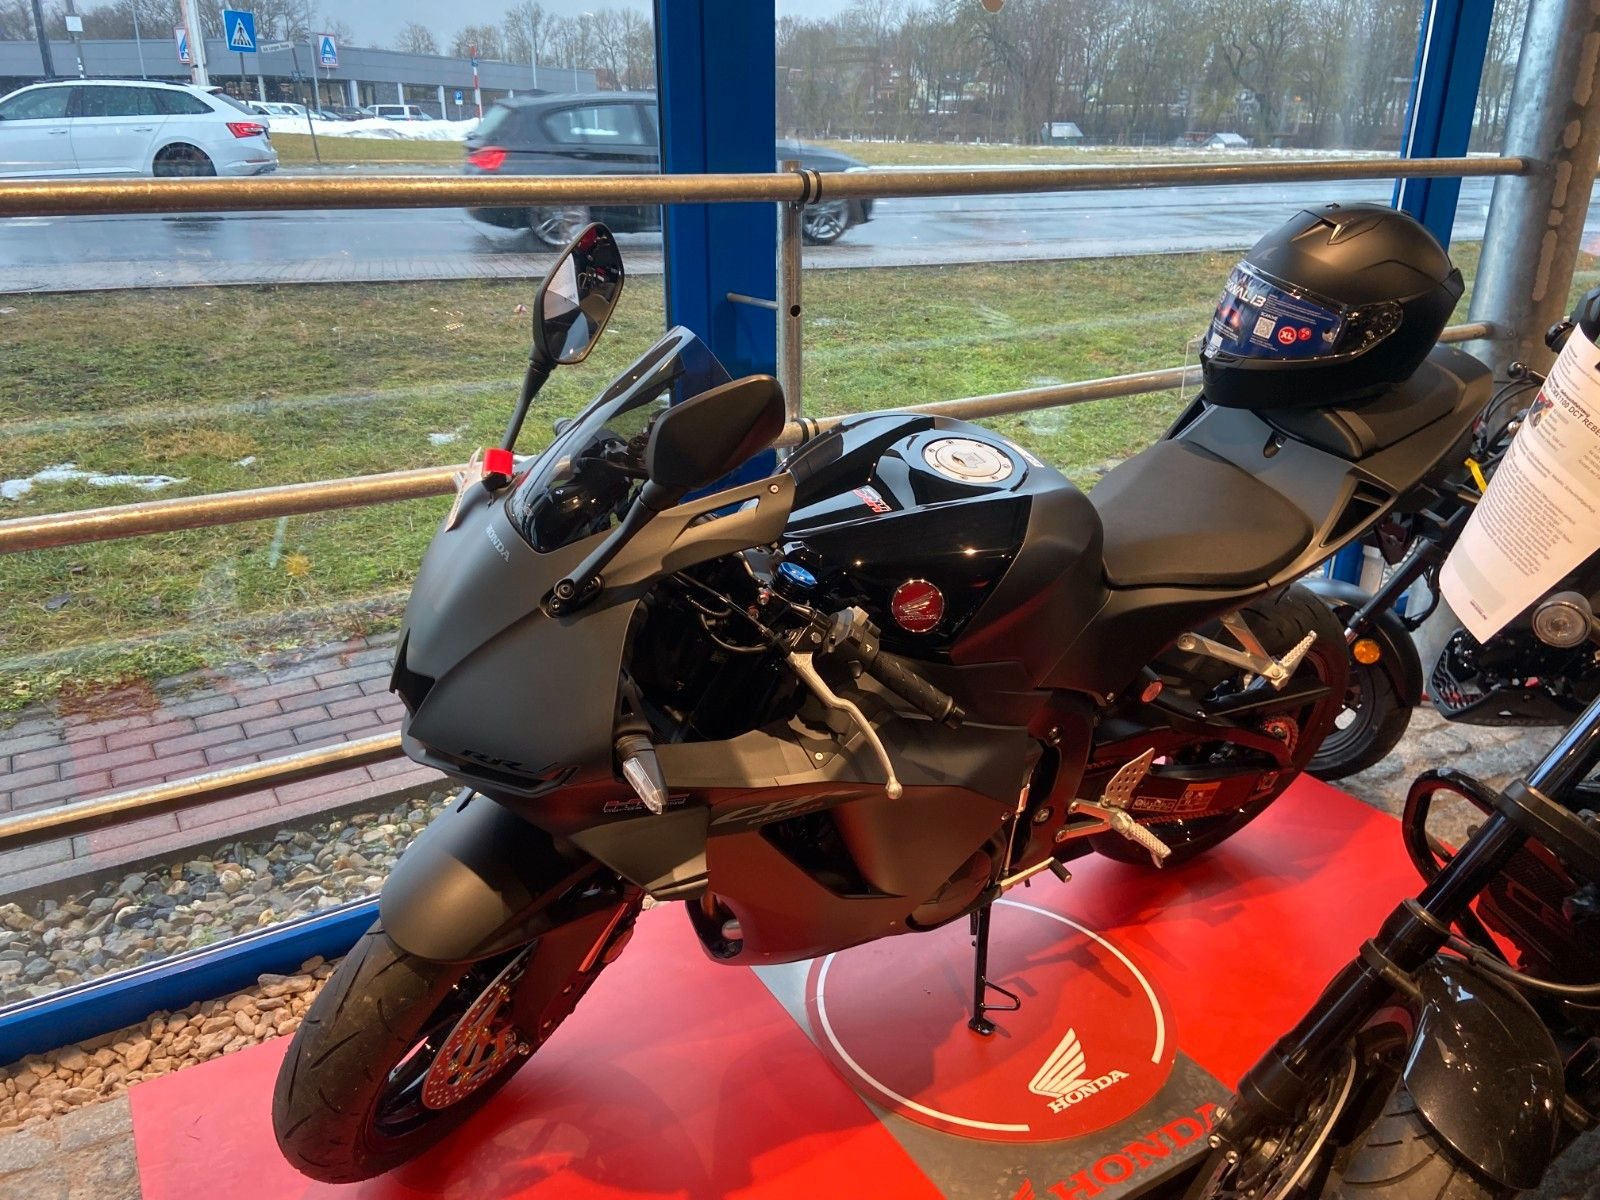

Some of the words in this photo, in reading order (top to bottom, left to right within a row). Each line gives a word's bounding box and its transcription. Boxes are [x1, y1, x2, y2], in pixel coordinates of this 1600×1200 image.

[1280, 330, 1294, 340] XL
[1568, 406, 1584, 419] DCT
[1582, 417, 1600, 438] REBE
[486, 522, 510, 562] HONDA
[1047, 1069, 1130, 1114] HONDA
